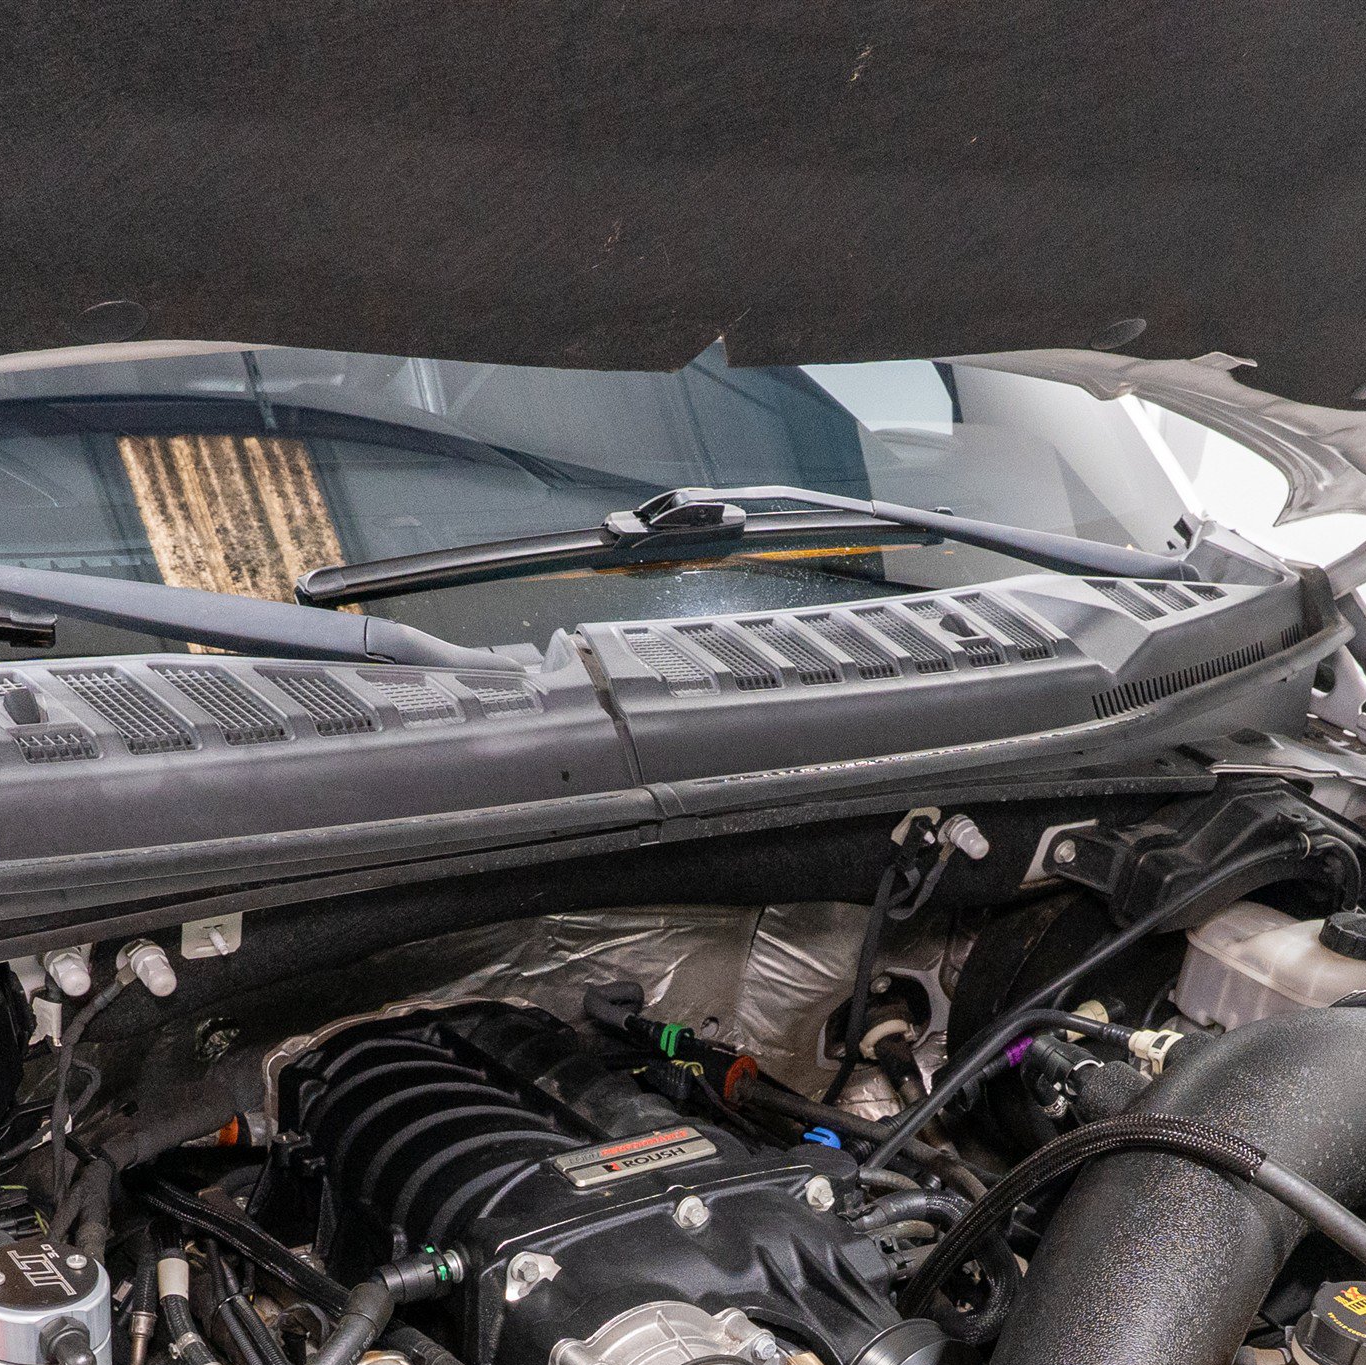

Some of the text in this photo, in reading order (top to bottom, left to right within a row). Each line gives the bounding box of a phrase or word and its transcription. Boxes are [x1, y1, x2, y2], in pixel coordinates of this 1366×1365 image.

[623, 1147, 686, 1168] ROUSH
[40, 1244, 60, 1259] 3.0
[7, 1250, 77, 1296] JLT
